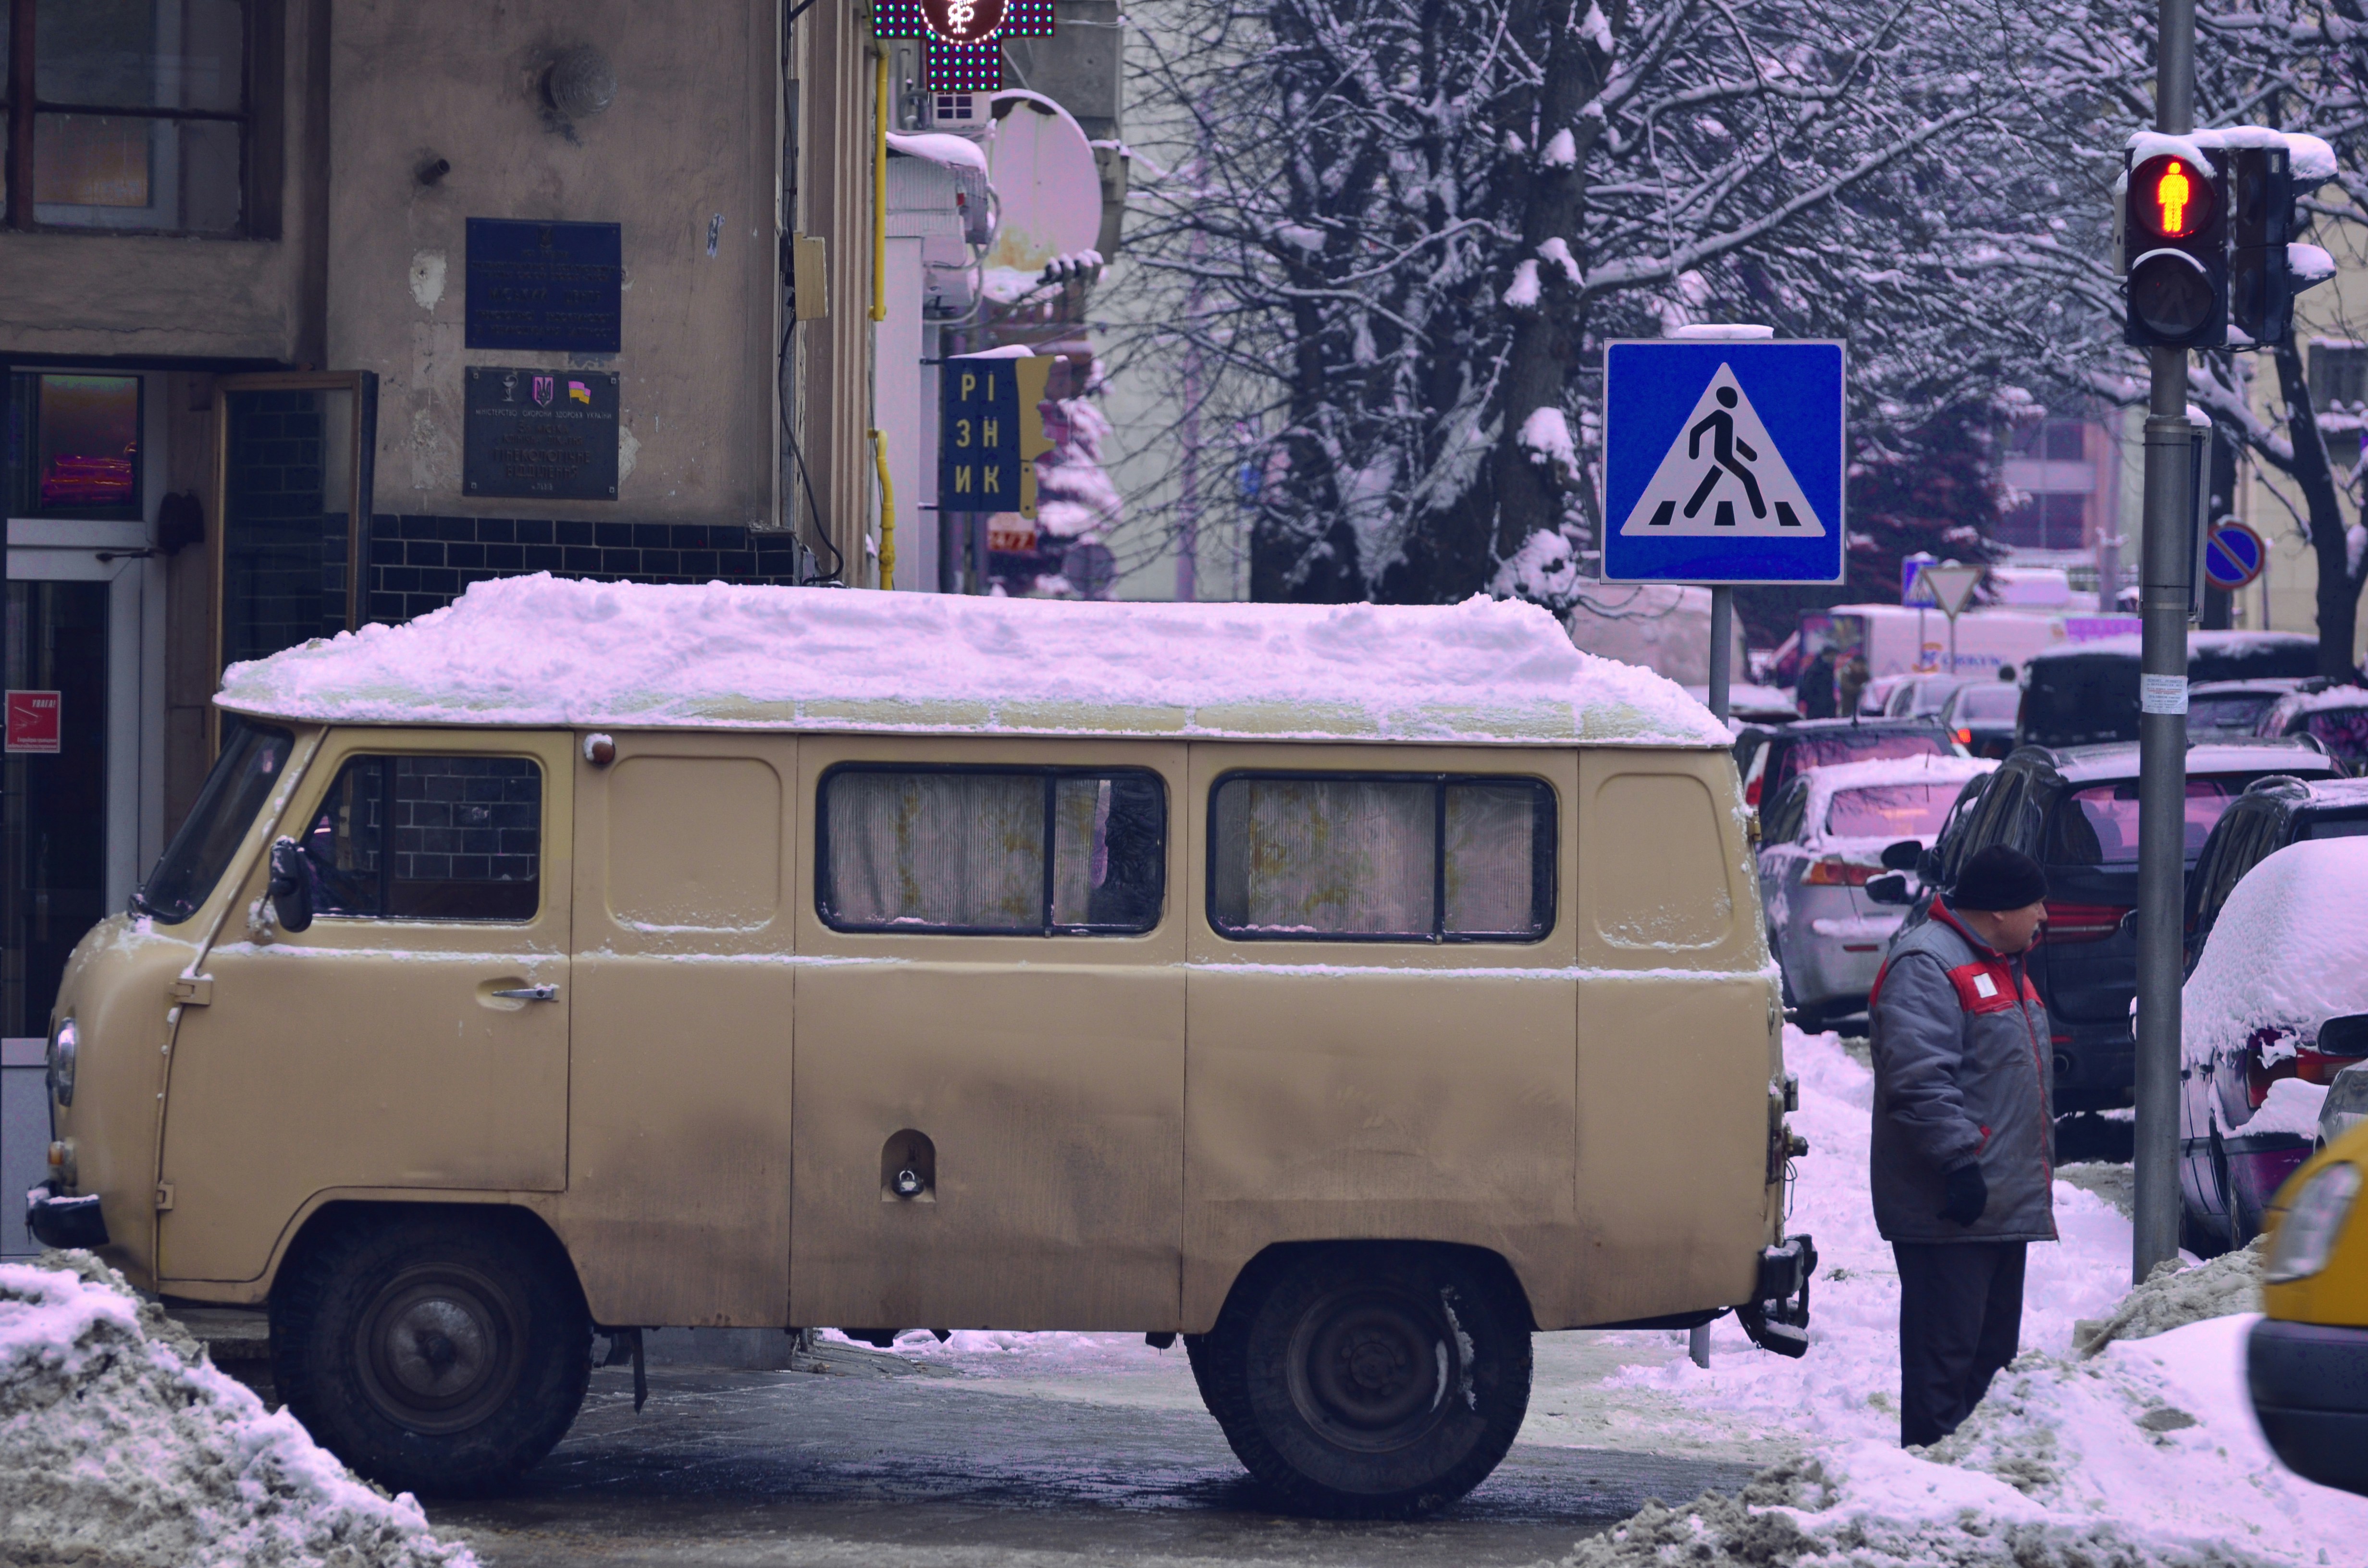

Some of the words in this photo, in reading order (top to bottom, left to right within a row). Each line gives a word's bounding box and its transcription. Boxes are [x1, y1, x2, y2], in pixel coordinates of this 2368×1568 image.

[586, 411, 612, 419] УКРАЇНИ
[493, 447, 591, 464] ГІНЕКОЛОГІЧНЕ
[506, 464, 579, 478] ВІДДІЛЕННЯ
[32, 699, 56, 708] УВАГА!
